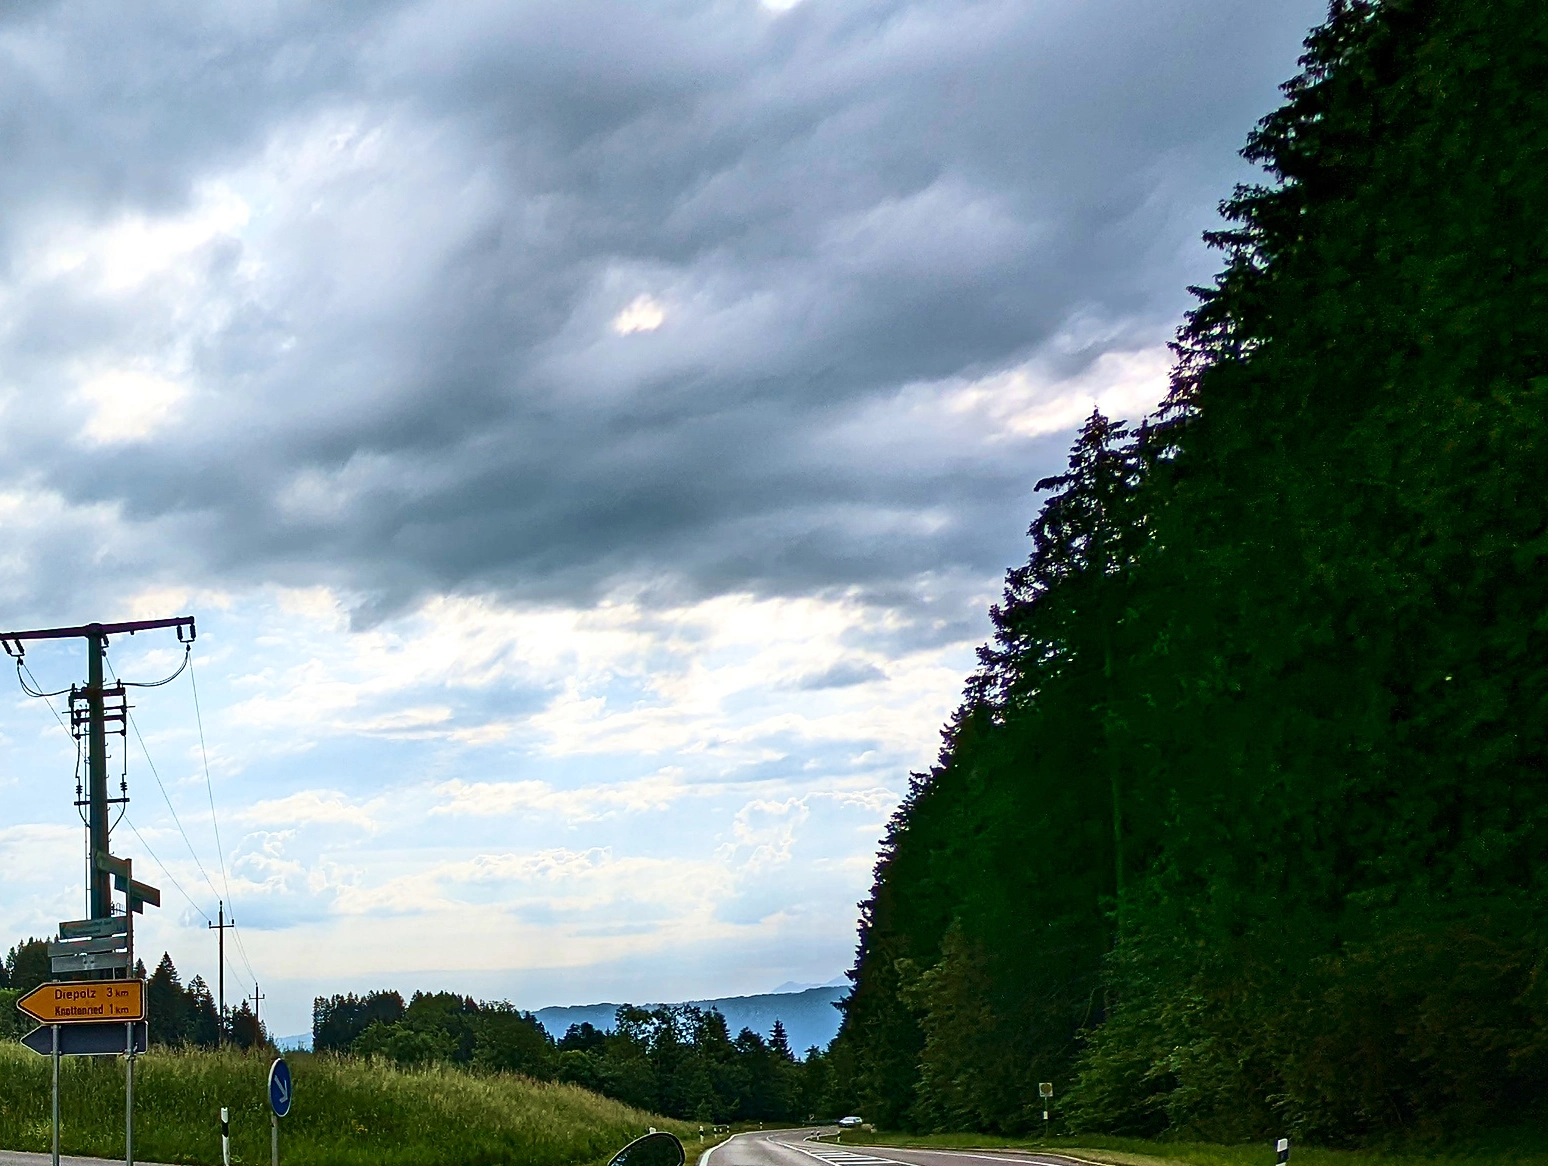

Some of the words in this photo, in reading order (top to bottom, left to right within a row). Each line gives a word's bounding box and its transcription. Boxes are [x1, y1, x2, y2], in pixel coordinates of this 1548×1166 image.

[54, 988, 97, 1001] Diepolz
[106, 987, 113, 998] 3
[115, 989, 129, 998] km
[54, 1004, 104, 1016] Knottenried
[109, 1004, 114, 1015] 1
[115, 1006, 129, 1015] km
